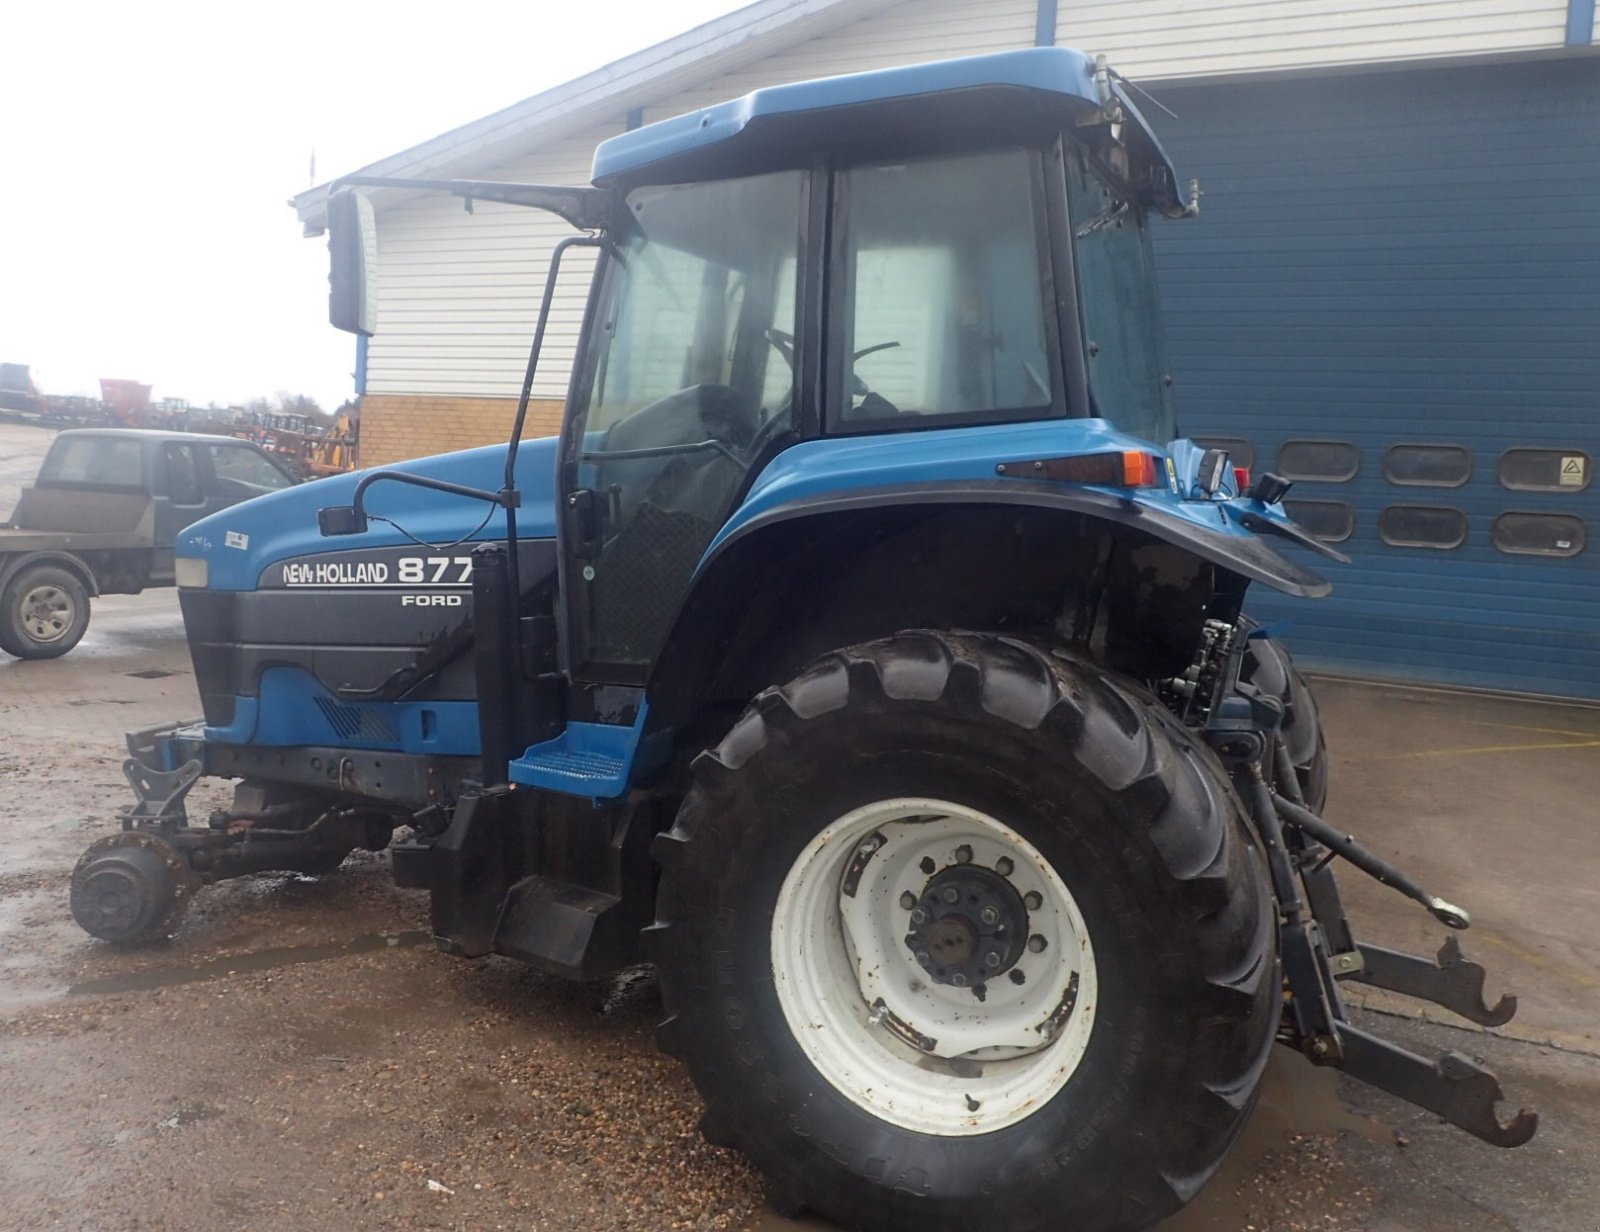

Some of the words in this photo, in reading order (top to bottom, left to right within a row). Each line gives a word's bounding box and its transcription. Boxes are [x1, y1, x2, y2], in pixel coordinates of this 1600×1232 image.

[283, 563, 313, 583] NEW
[316, 563, 388, 583] HOLLAND
[398, 557, 473, 583] 877
[401, 595, 462, 606] FORD
